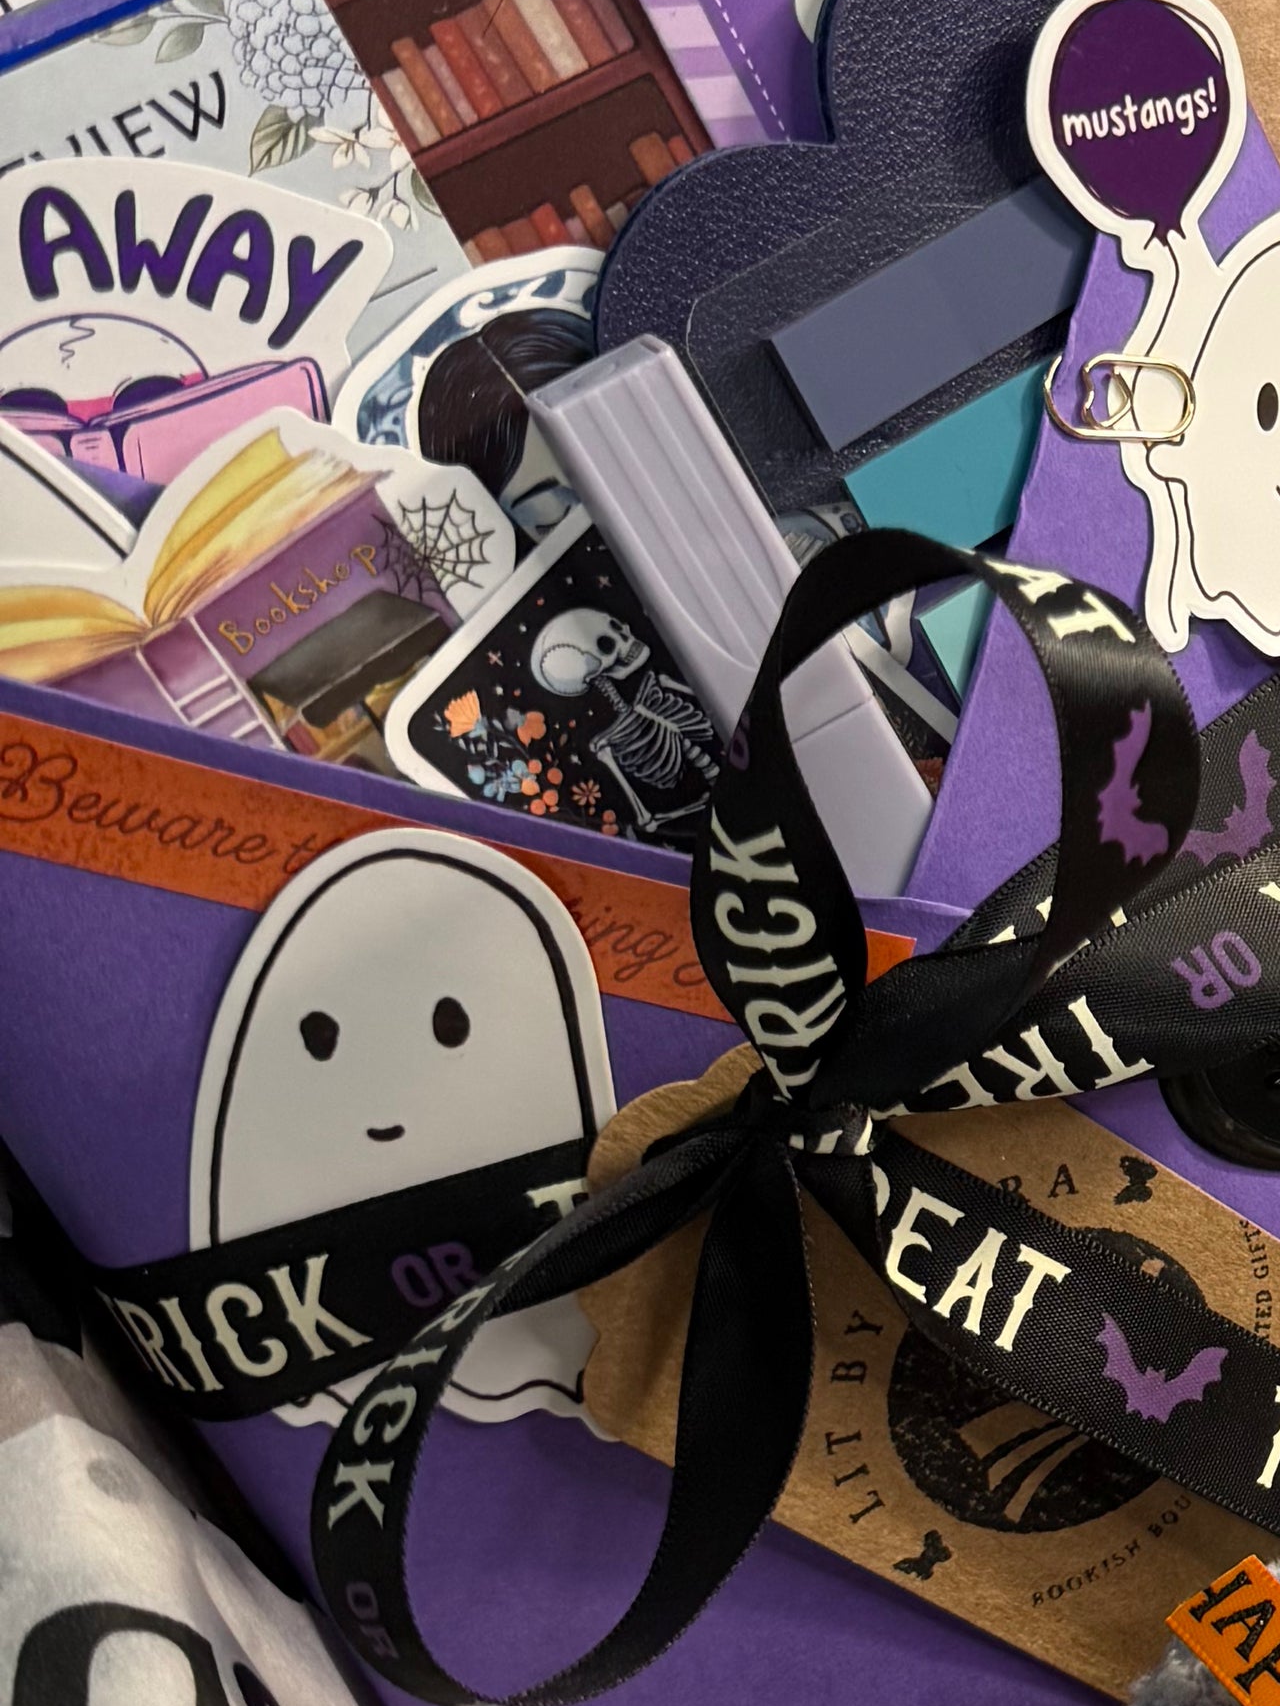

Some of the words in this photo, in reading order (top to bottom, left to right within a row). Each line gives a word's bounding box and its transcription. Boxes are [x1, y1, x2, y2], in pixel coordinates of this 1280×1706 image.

[1062, 76, 1218, 146] mustangs!
[19, 186, 364, 349] AWAY
[1170, 930, 1263, 1010] OR
[872, 1165, 1072, 1353] EAT
[98, 1252, 374, 1392] RICK
[831, 1309, 884, 1385] BY
[825, 1429, 886, 1525] LIT
[1031, 1538, 1142, 1608] BOOKISH
